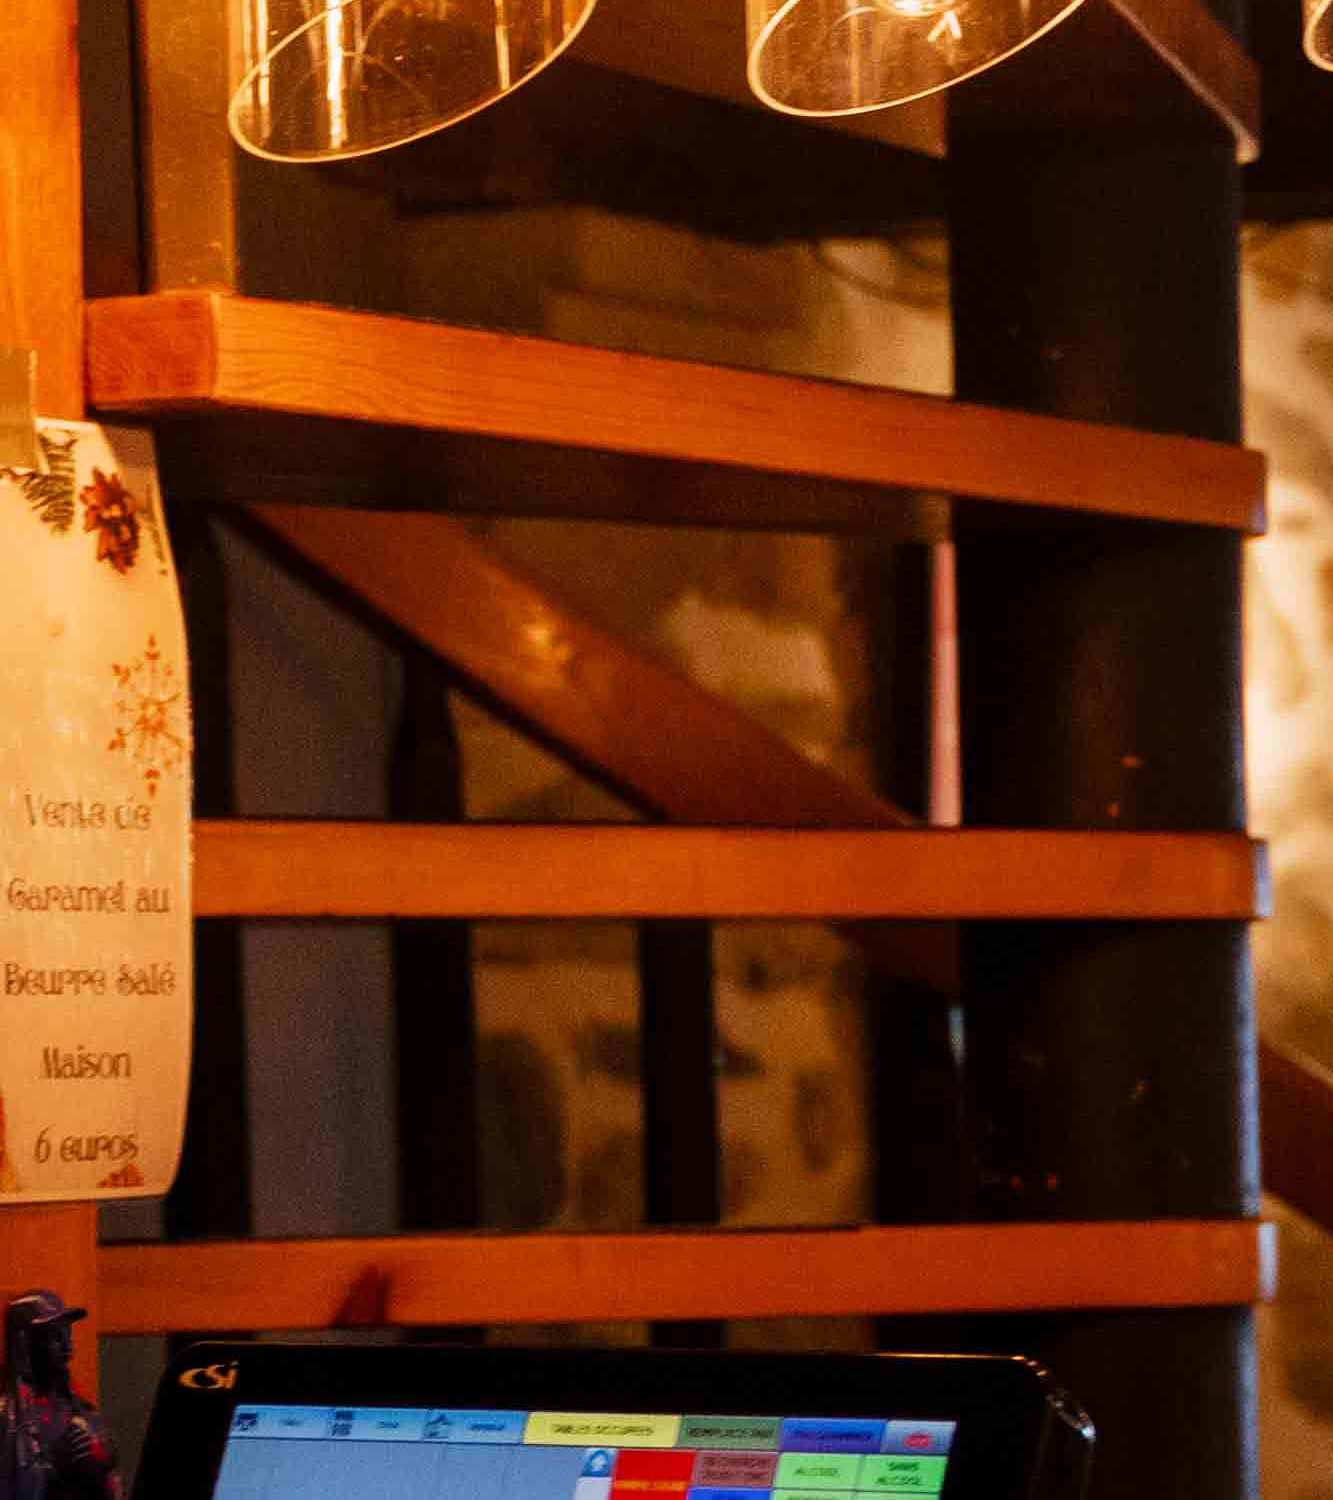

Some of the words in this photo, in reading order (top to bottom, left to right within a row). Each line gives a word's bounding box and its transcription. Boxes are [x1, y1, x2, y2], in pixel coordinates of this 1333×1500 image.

[24, 793, 105, 828] Vente
[113, 795, 151, 830] de
[135, 886, 170, 913] au
[42, 1045, 131, 1079] Maison
[34, 1128, 51, 1164] 6
[60, 1133, 139, 1162] euros
